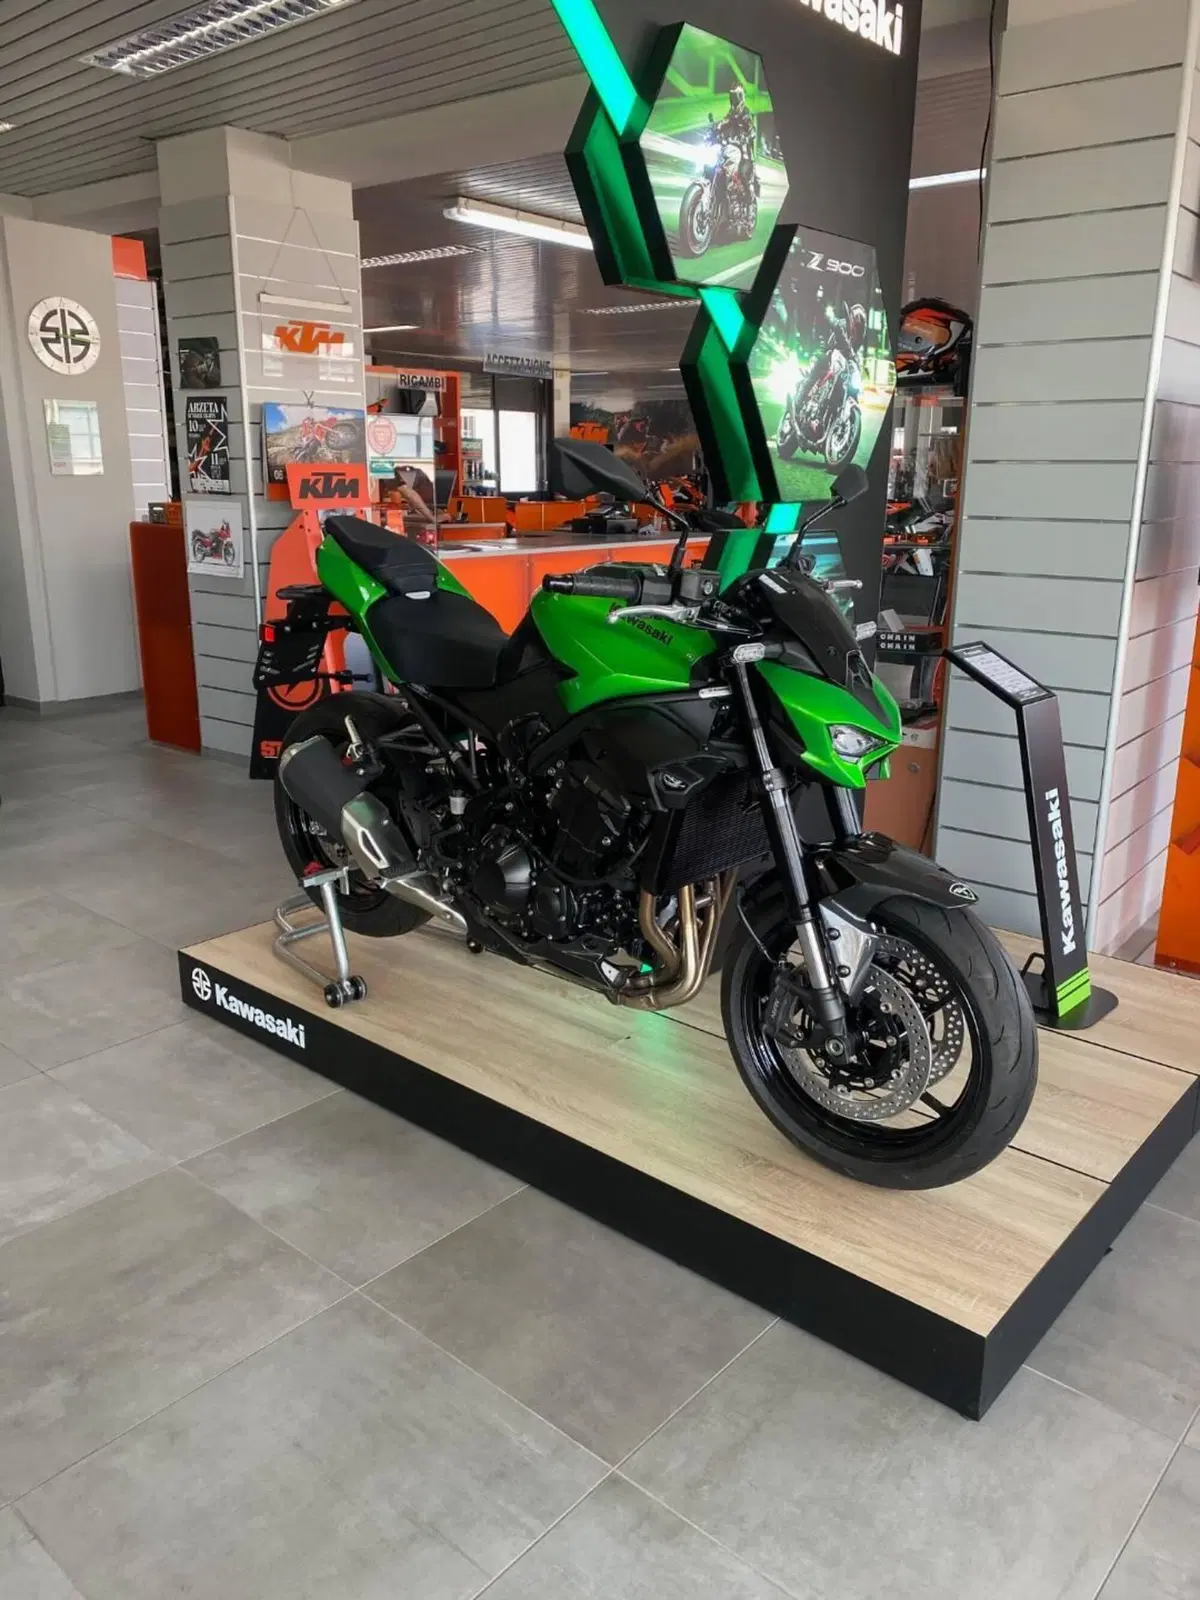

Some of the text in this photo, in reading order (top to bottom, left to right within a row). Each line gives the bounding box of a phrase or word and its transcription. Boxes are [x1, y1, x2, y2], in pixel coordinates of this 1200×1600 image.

[826, 258, 865, 277] 900
[274, 320, 345, 355] KTM
[399, 373, 445, 389] RICAMBI
[298, 472, 360, 499] KTM
[1045, 788, 1077, 955] Kawasaki
[214, 983, 306, 1049] Kawasaki
